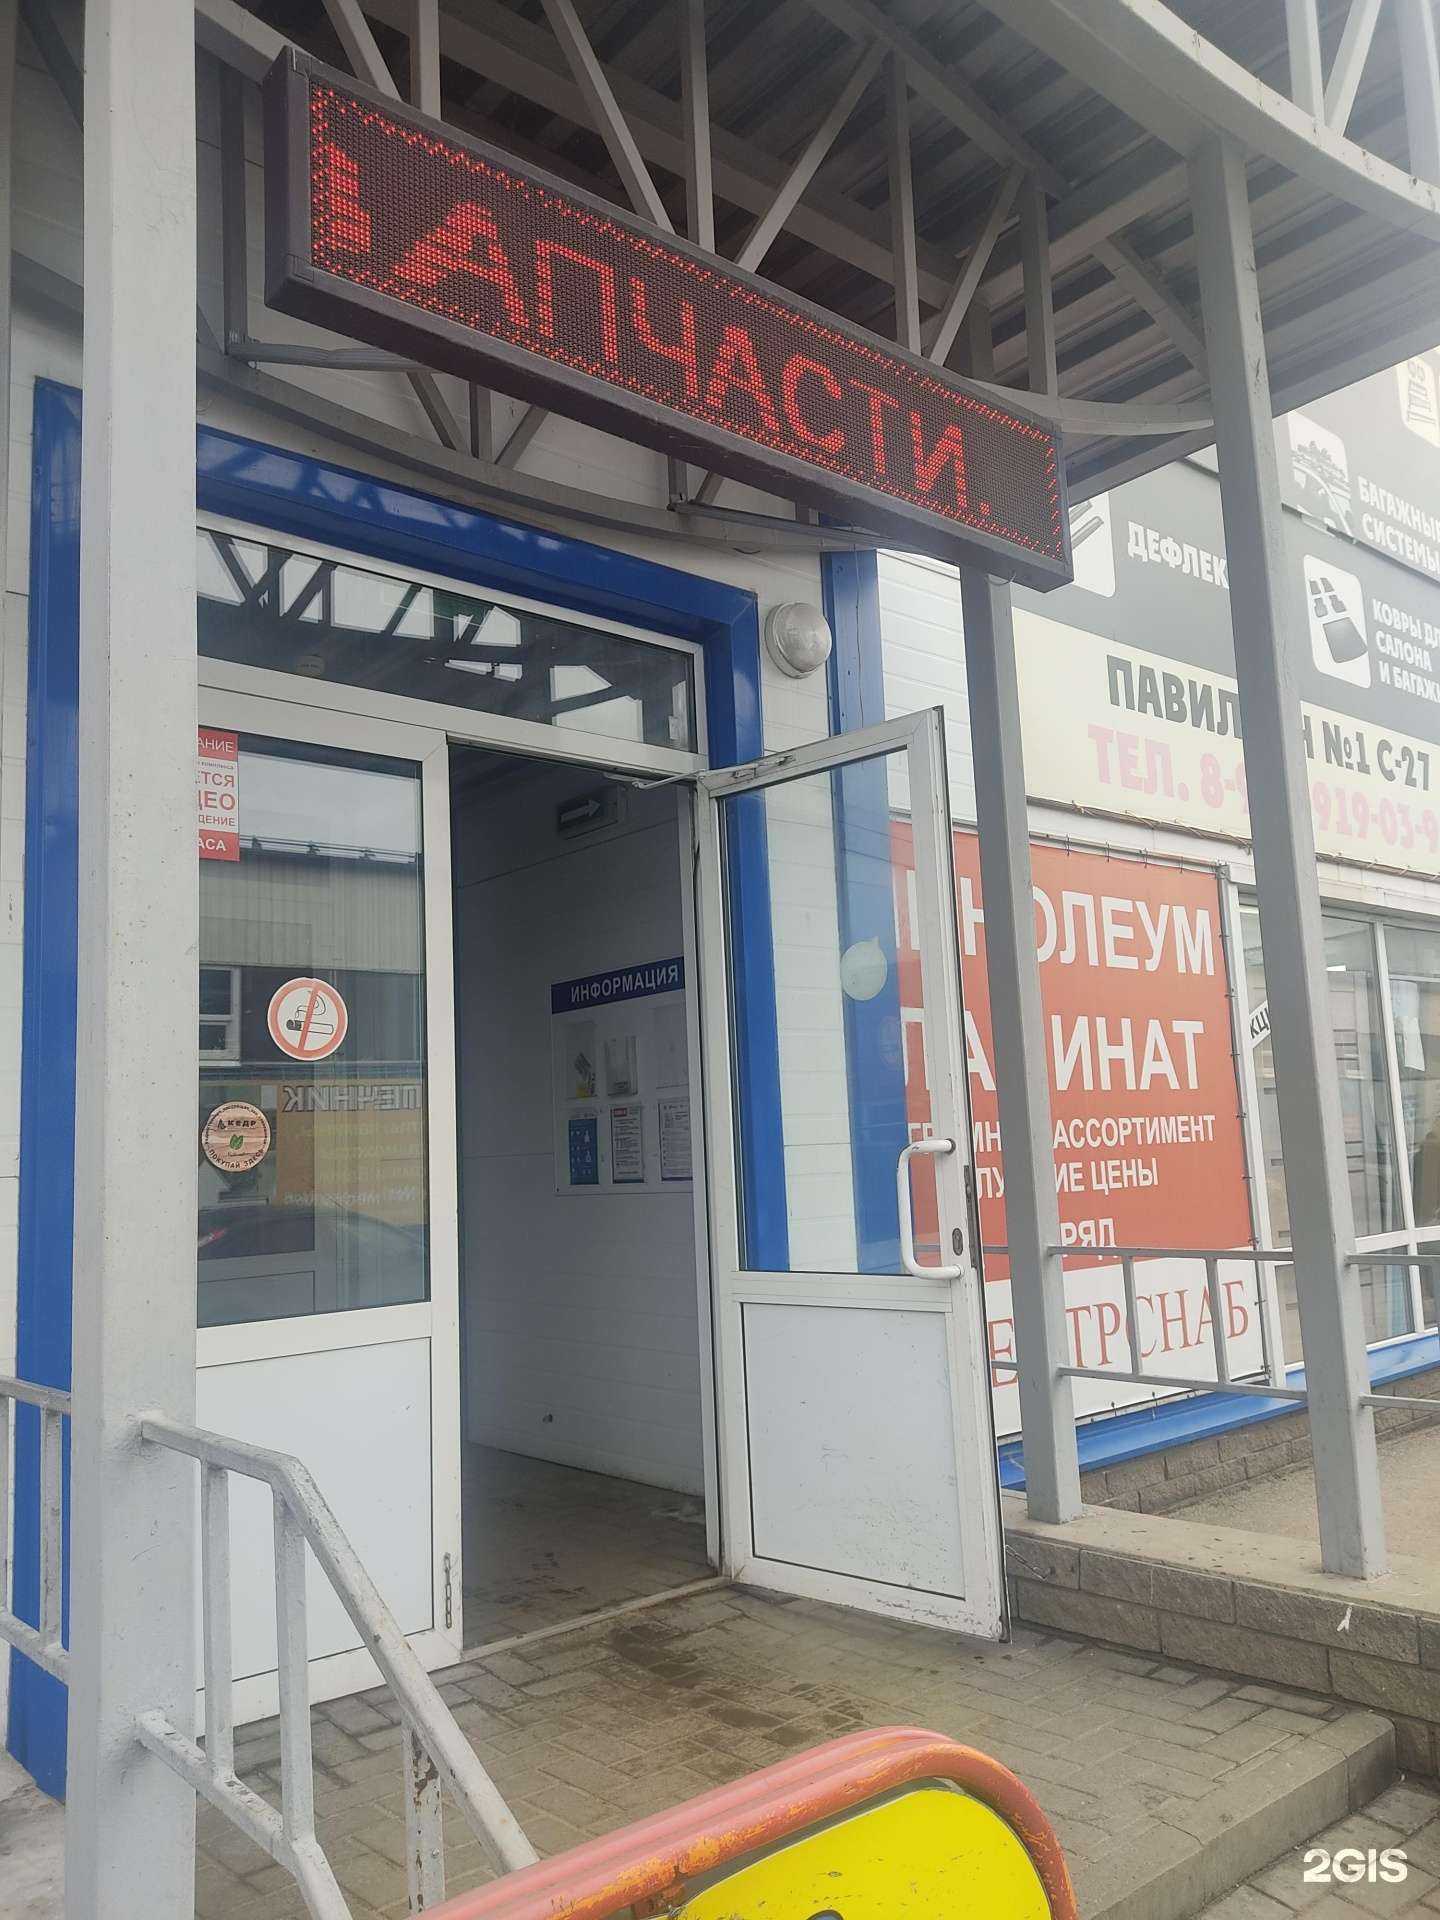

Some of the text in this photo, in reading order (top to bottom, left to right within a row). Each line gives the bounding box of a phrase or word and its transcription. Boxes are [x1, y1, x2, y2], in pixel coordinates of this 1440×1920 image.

[1361, 512, 1440, 574] СИСТЕМЫ
[1371, 598, 1423, 640] КОВРЫ
[1375, 630, 1432, 672] САЛОНА
[1378, 660, 1391, 685] И
[1088, 723, 1190, 803] ТЕЛ.
[1321, 720, 1371, 775] №1
[1376, 738, 1430, 791] С-27
[198, 770, 235, 788] ТСЯ
[570, 964, 679, 1004] ИНФОРМАЦИЯ
[900, 1005, 1205, 1092] ЛАИНАТ
[1053, 1114, 1216, 1151] АССОРТИМЕНТ
[208, 1147, 241, 1169] ПОКУПАЙ
[976, 1157, 1160, 1200] ЛУИЕ ЦЕНЫ
